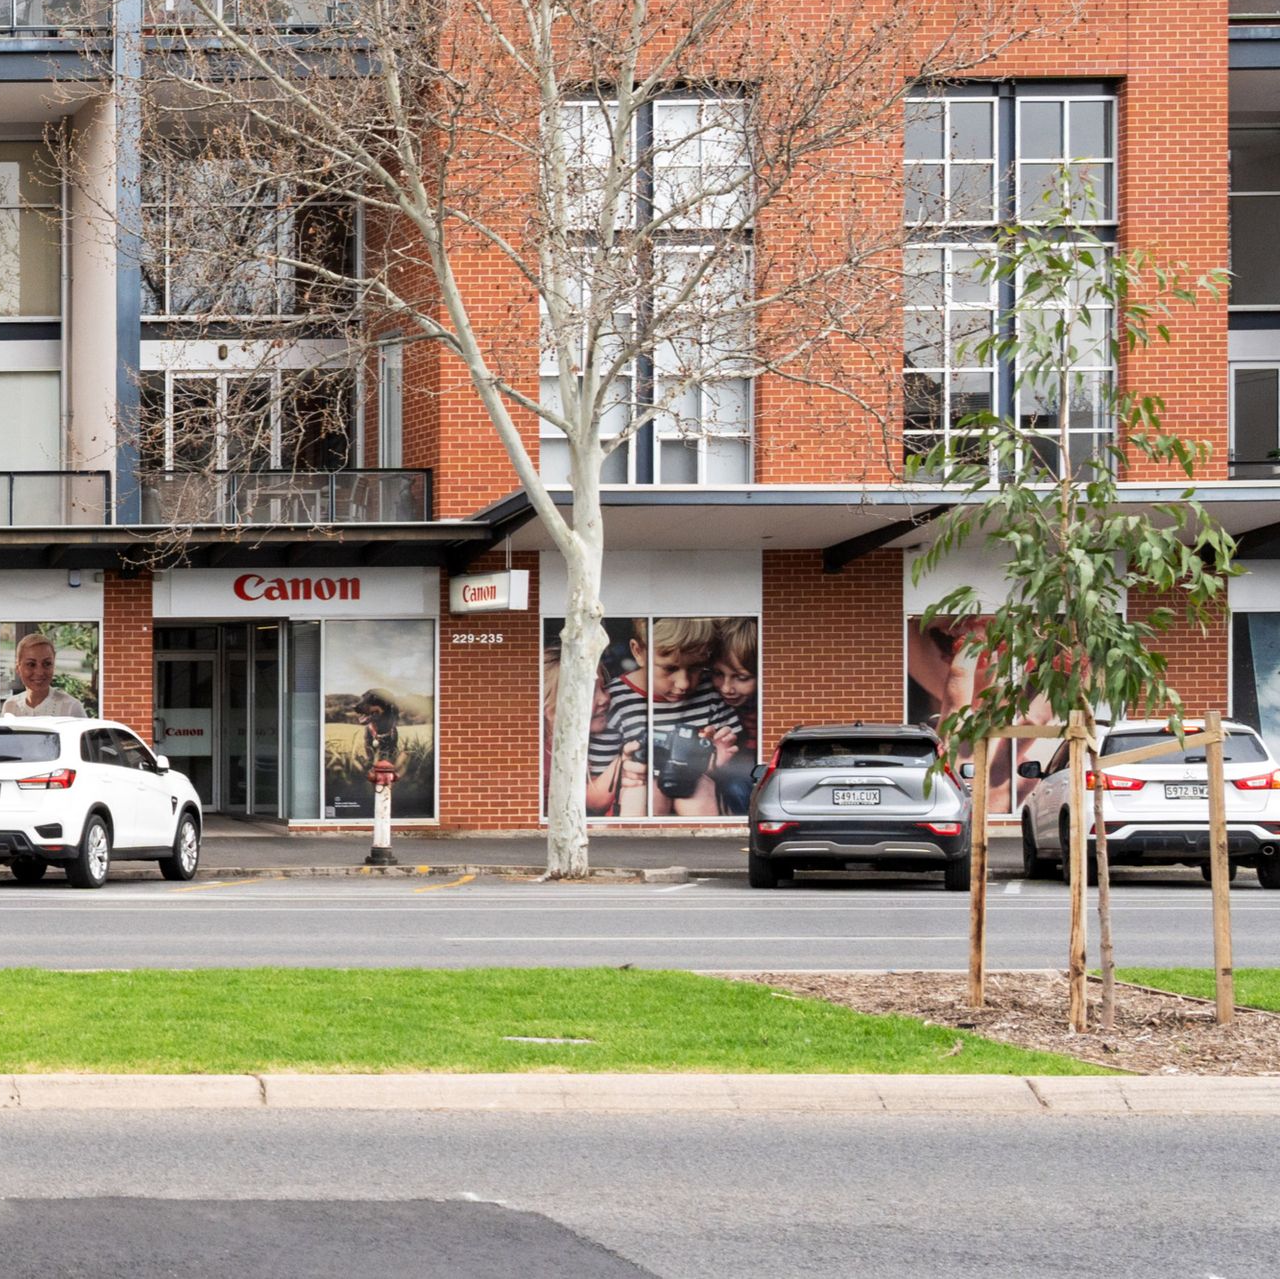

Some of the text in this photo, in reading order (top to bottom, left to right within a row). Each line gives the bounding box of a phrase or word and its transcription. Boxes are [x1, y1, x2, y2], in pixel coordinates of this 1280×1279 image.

[233, 574, 360, 601] Canon
[462, 584, 497, 603] Canon
[452, 633, 504, 644] 229-235
[165, 727, 204, 737] Canon
[835, 791, 878, 801] S491 CUX
[1166, 786, 1189, 796] S972
